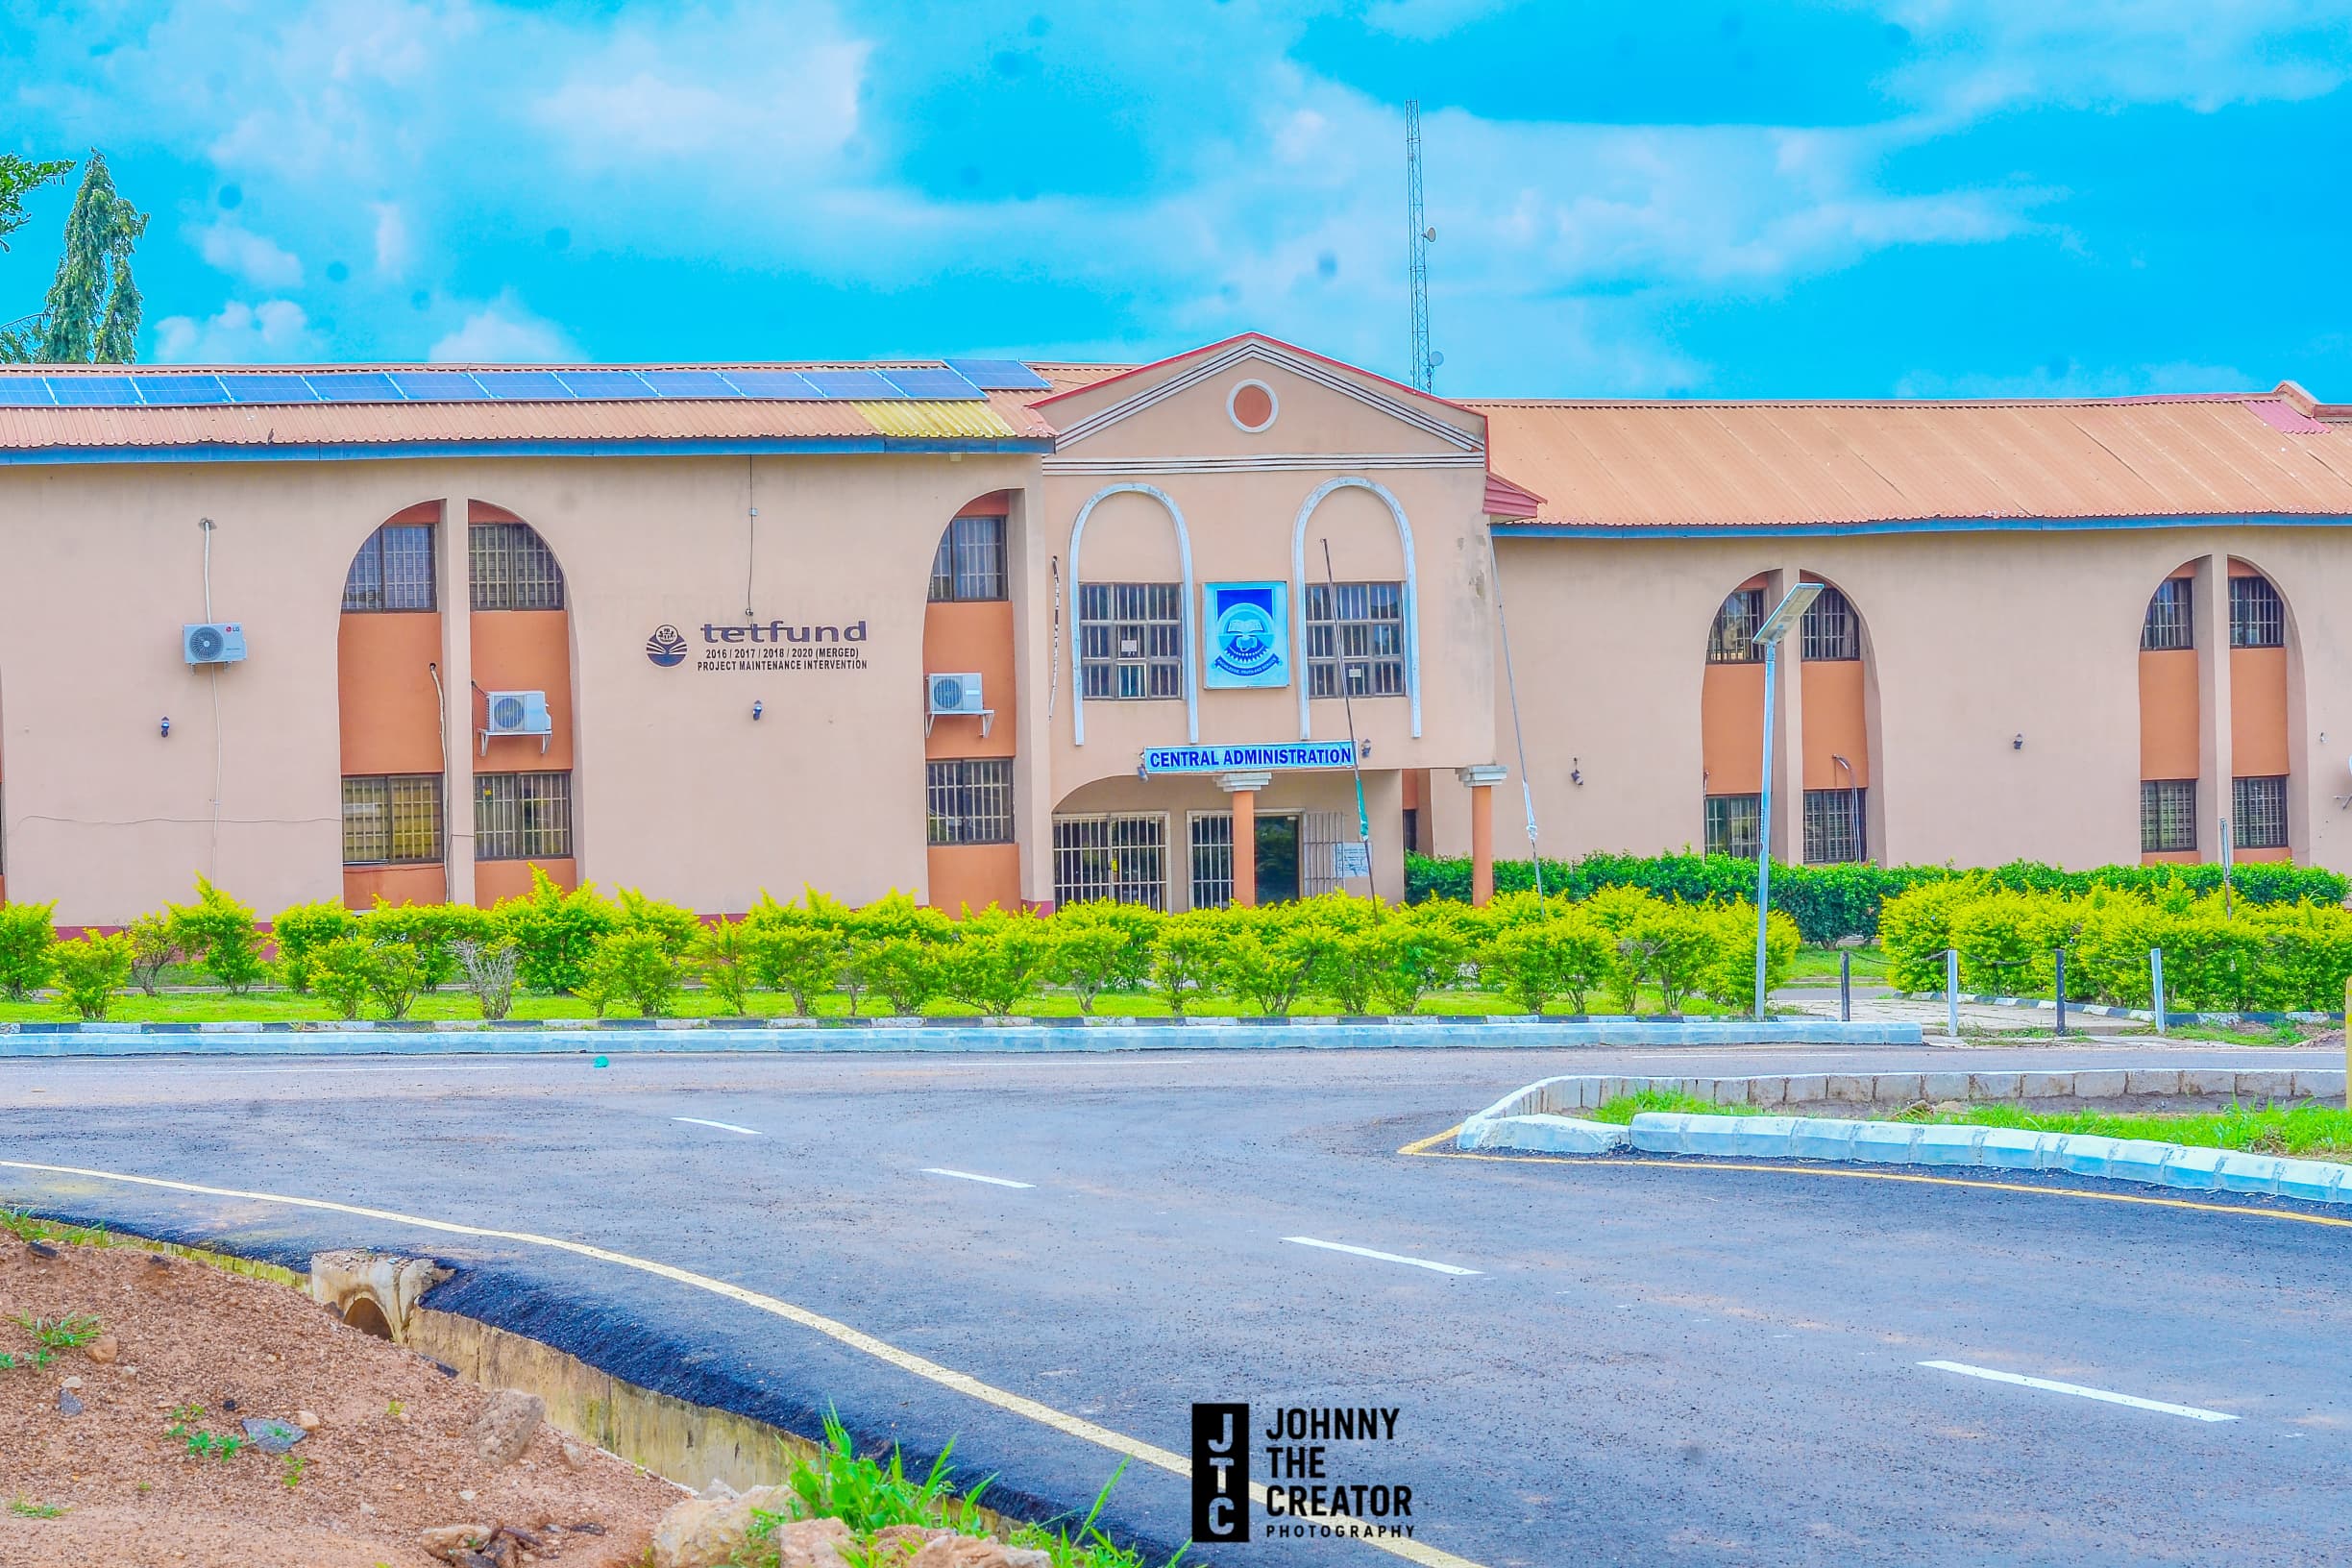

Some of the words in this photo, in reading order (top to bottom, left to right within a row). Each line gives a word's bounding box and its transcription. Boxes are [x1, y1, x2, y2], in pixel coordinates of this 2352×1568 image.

[699, 621, 867, 643] tetfund
[705, 649, 727, 659] 2016
[734, 649, 756, 658] 2017
[763, 648, 784, 658] 2018
[792, 648, 814, 658] 2020
[816, 648, 859, 659] (MERGED)
[698, 661, 737, 672] PROJECT
[739, 660, 801, 671] MAINTENANCE
[803, 659, 868, 670] INTERVENTION
[1150, 749, 1219, 768] CENTRAL
[1223, 747, 1351, 766] ADMINISTRATION
